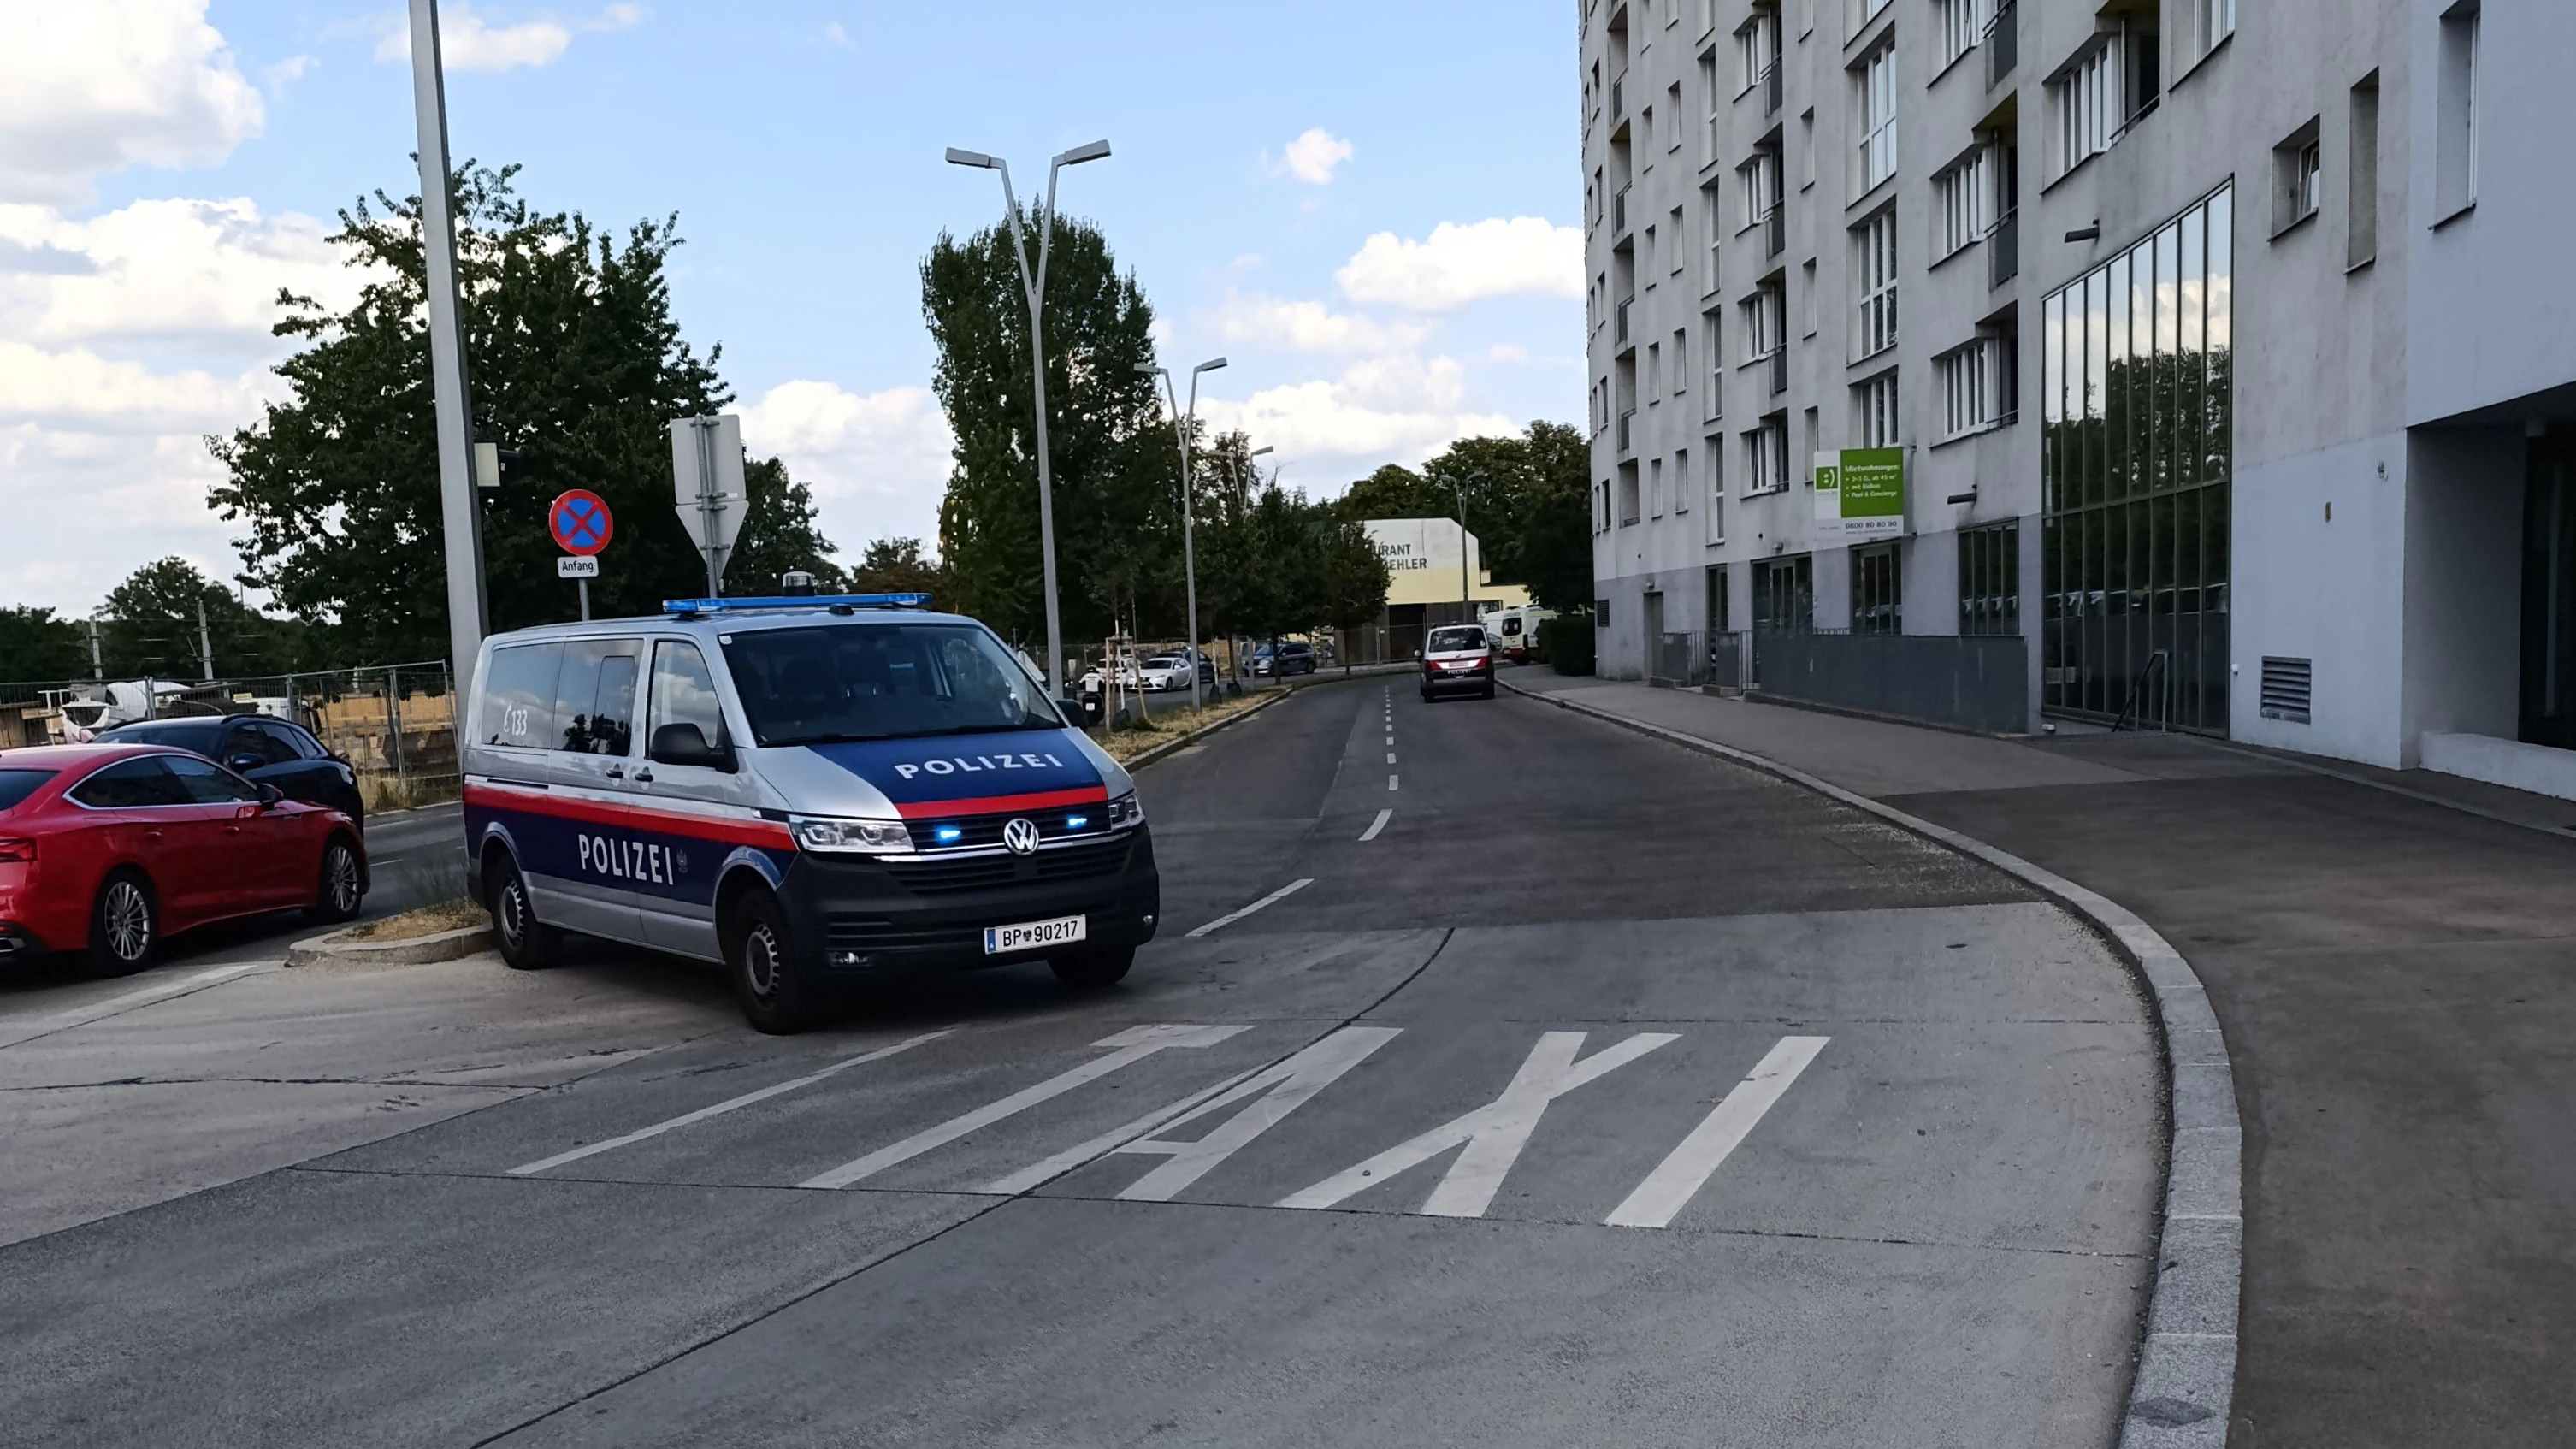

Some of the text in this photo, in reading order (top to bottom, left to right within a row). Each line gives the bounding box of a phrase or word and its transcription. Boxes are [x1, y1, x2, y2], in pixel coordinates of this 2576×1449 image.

[562, 561, 594, 572] Anfang
[1384, 558, 1427, 571] EHLER
[511, 709, 528, 736] 133
[895, 754, 1063, 779] POLIZEI
[578, 834, 674, 885] POLIZEI
[1002, 920, 1078, 947] BP 90217
[795, 1024, 1832, 1228] TAXI
